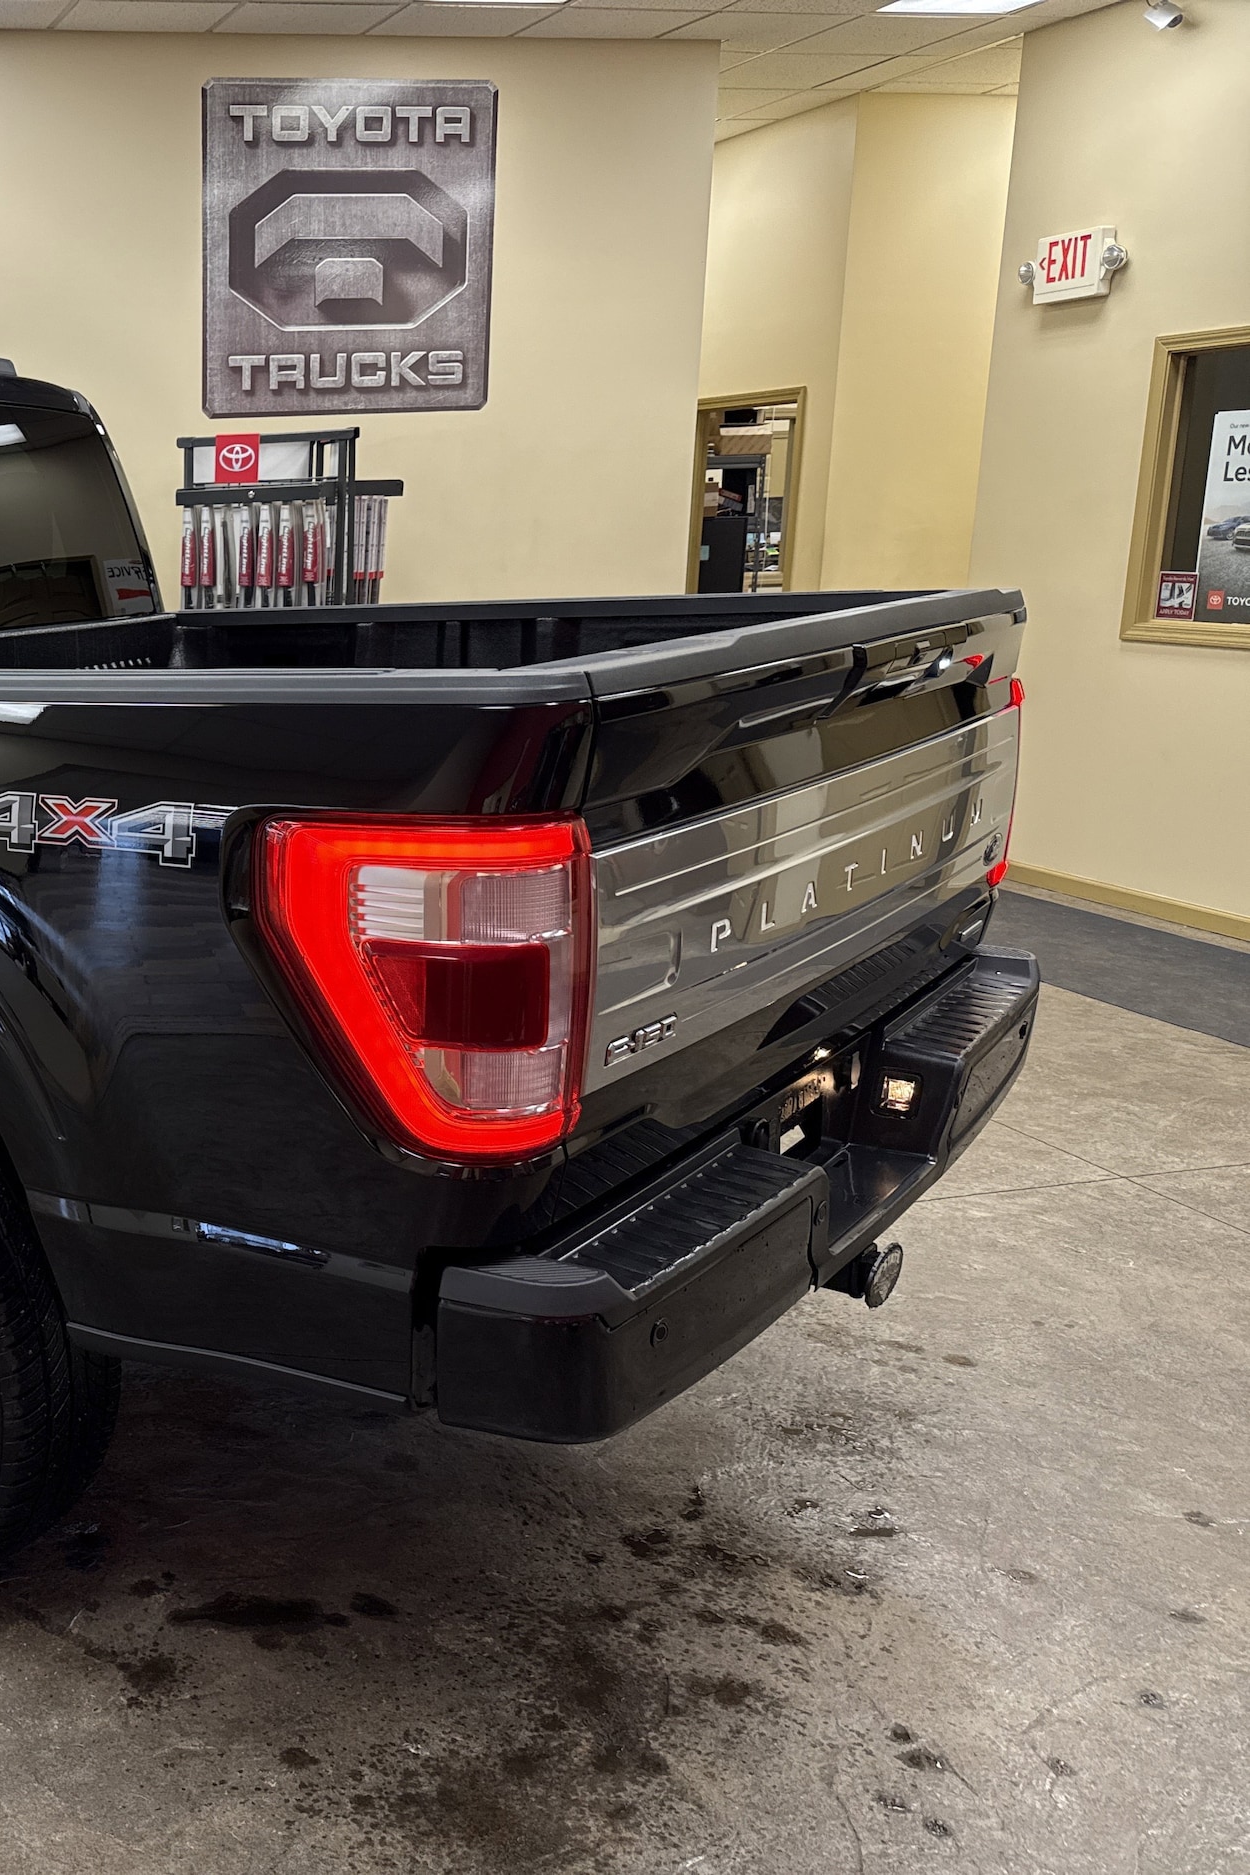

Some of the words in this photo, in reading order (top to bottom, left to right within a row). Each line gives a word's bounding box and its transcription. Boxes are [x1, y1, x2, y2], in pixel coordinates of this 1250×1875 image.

[229, 104, 471, 143] TOYOTA
[1046, 233, 1092, 284] EXIT
[227, 350, 464, 391] TRUCKS
[1227, 434, 1250, 456] M
[1223, 461, 1250, 482] Le
[711, 798, 983, 954] PLATINUM
